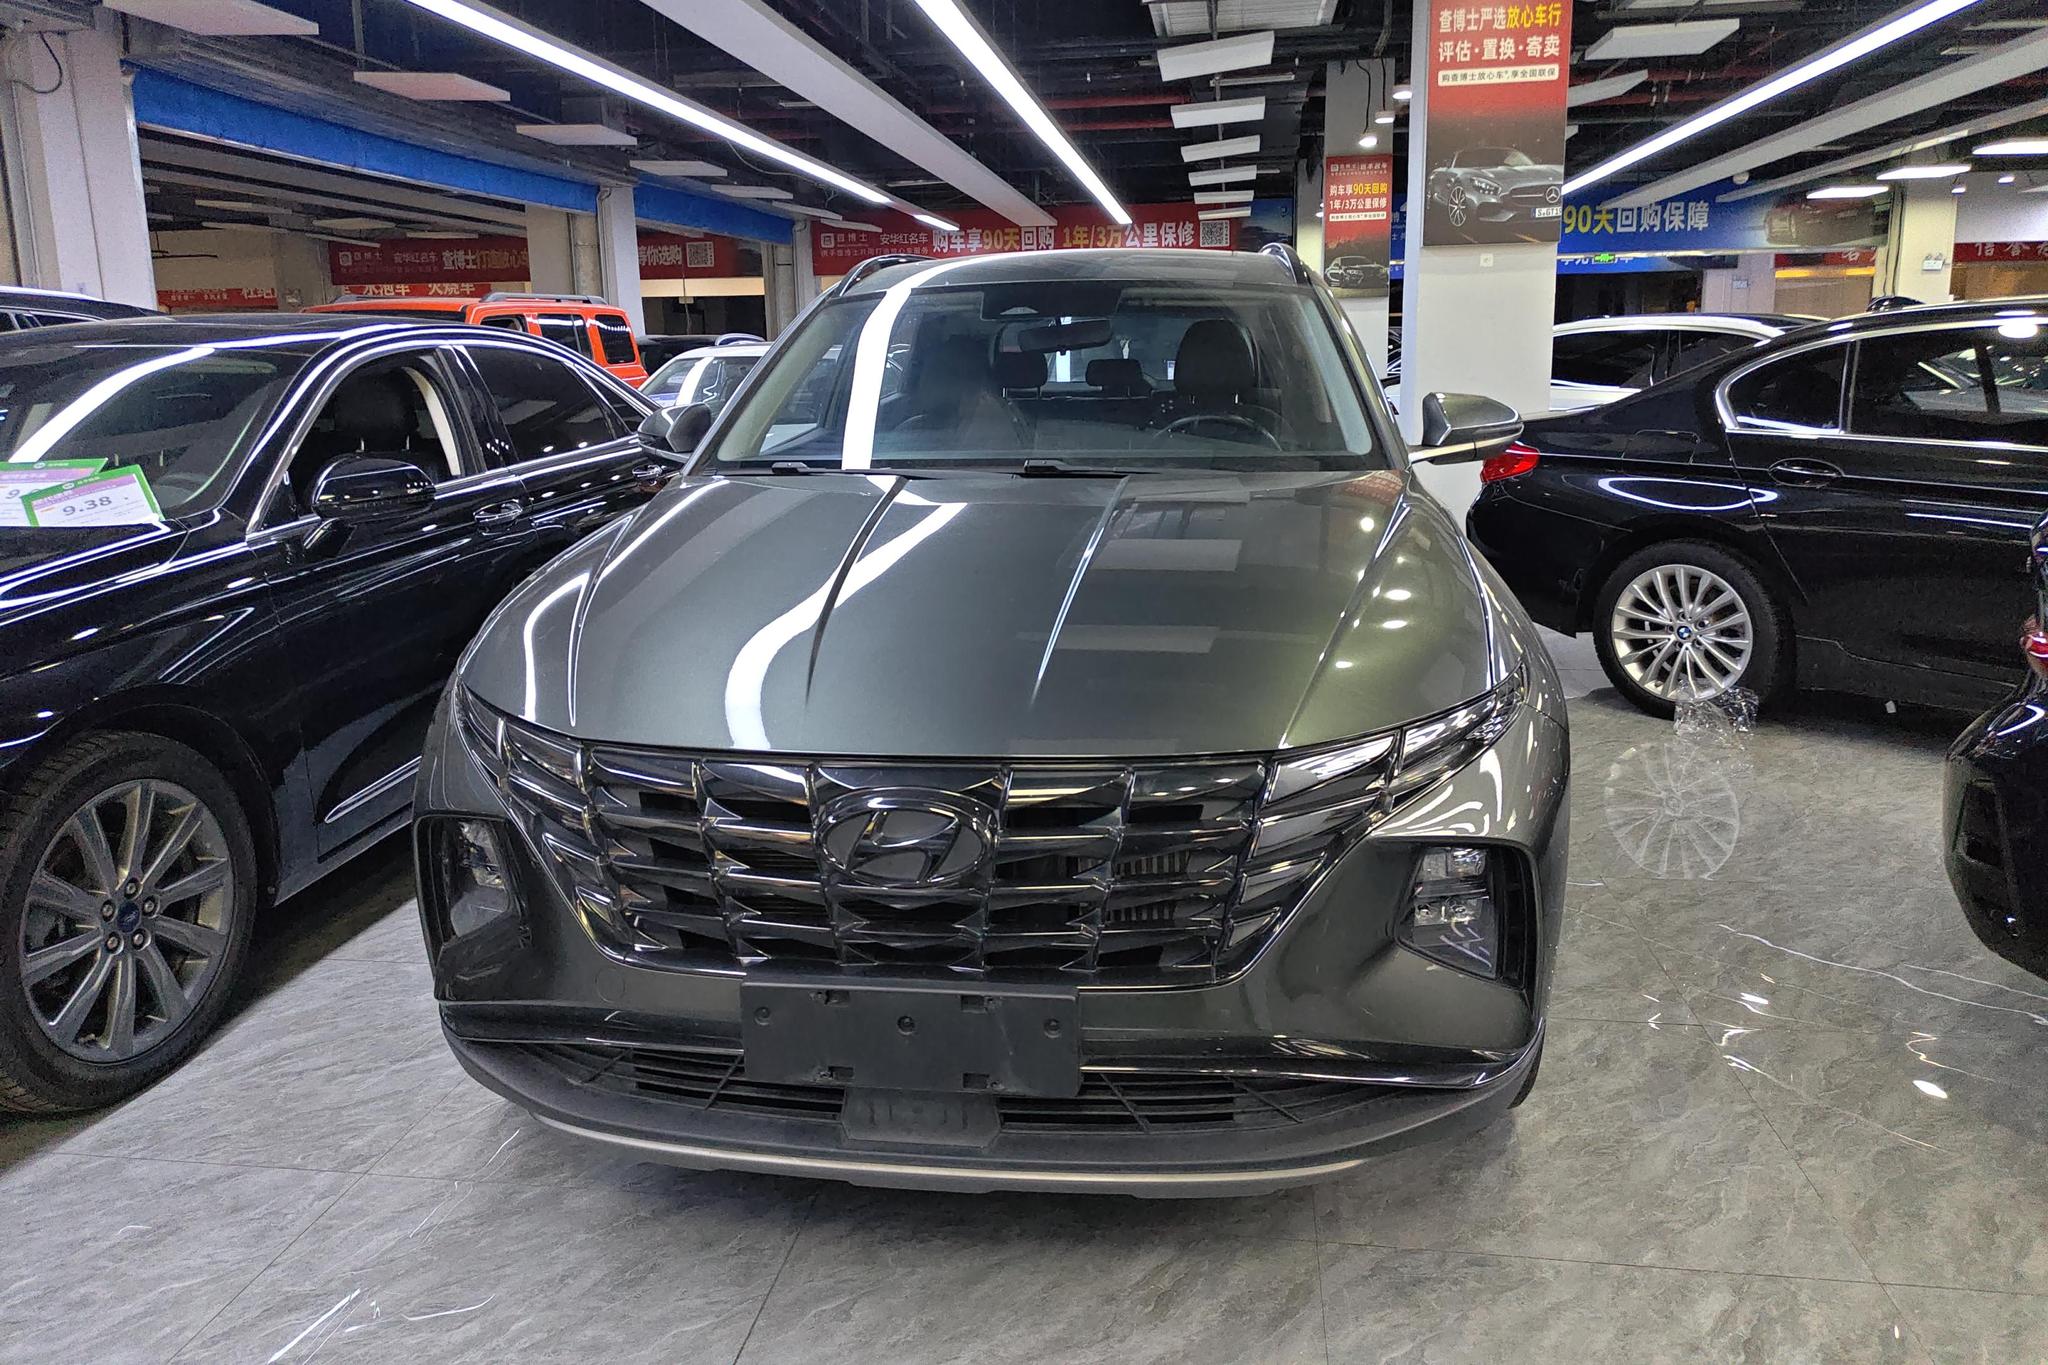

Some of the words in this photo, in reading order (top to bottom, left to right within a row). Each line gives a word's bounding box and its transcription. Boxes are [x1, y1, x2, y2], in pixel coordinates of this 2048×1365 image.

[1440, 3, 1561, 32] 查博士严选放心车行
[1329, 182, 1388, 197] 购车享90天回购
[1329, 197, 1387, 210] 1年/3万公里保修
[1563, 202, 1709, 235] 90天回购保障
[932, 223, 1056, 253] 购车享90天回购
[1063, 221, 1195, 249] 1年/3万公里保修
[62, 496, 113, 516] 9.38
